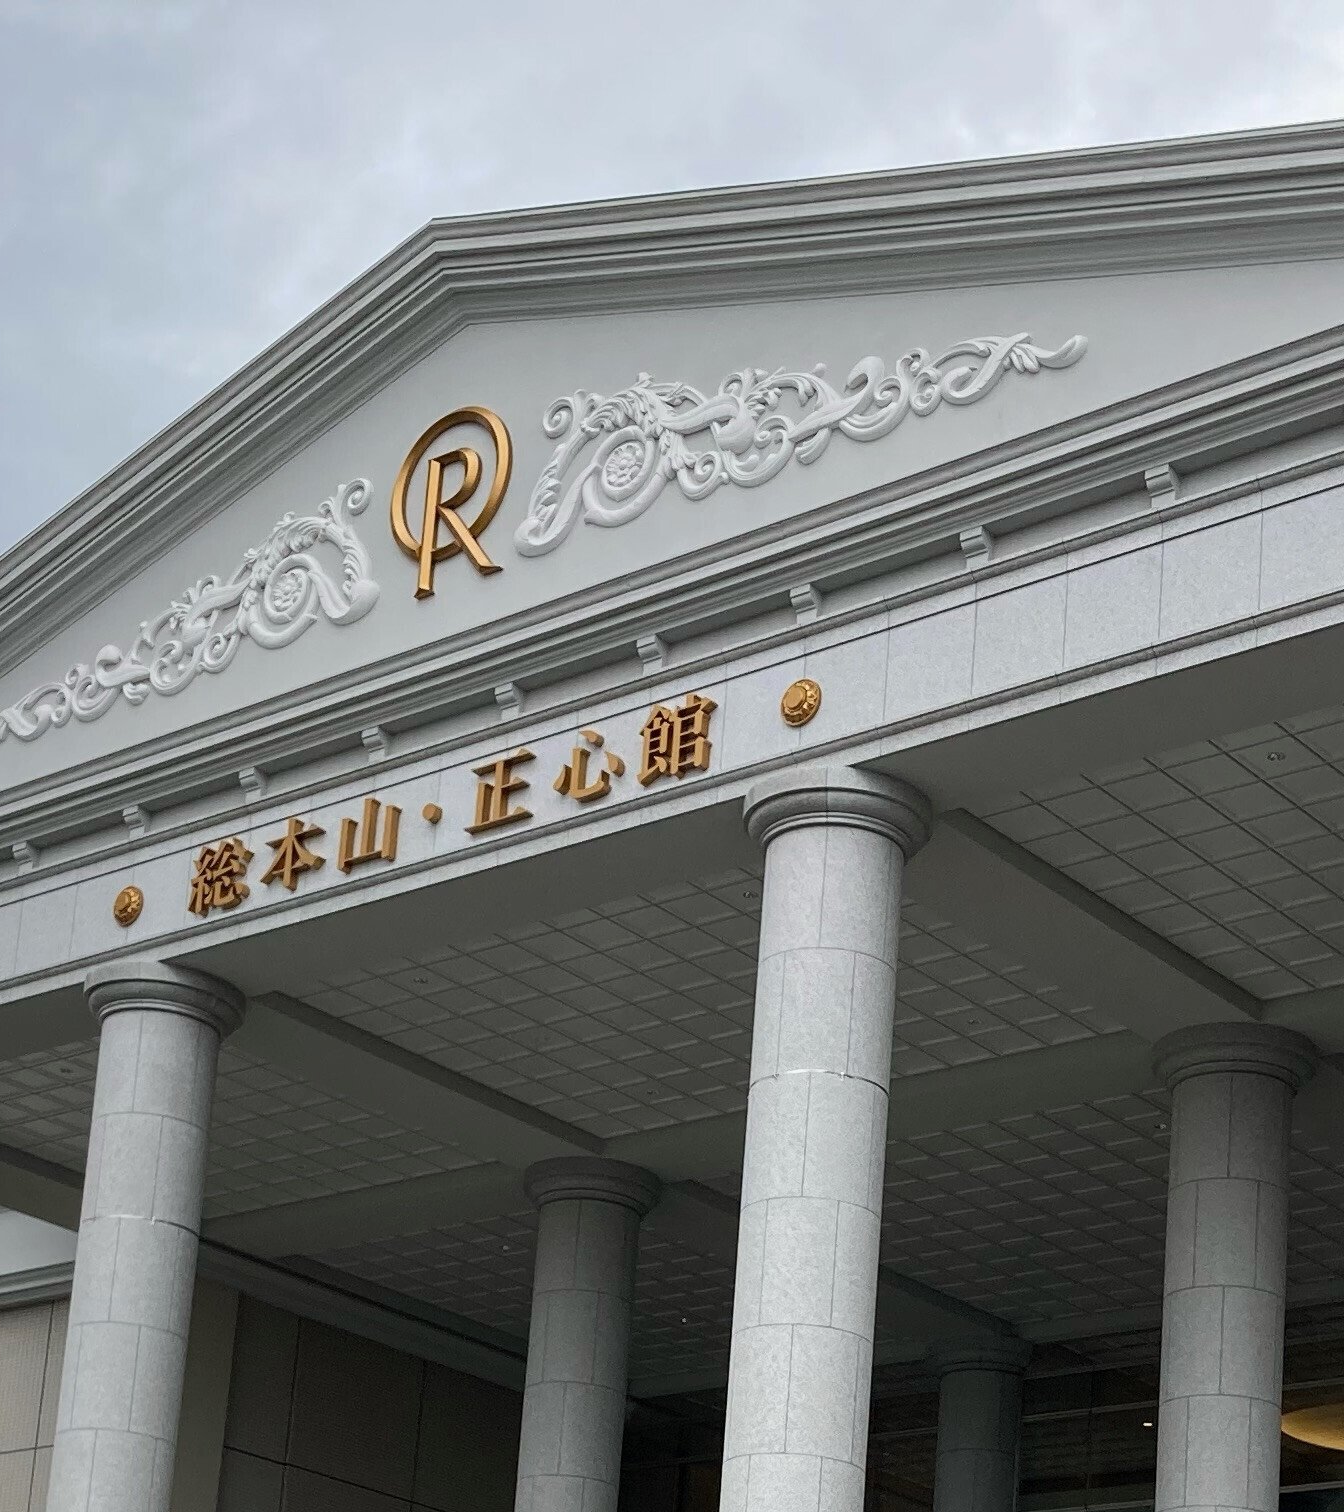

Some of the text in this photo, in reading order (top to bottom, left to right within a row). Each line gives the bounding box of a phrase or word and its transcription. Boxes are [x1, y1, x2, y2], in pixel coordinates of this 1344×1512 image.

[187, 693, 719, 918] 総本山・正心館
